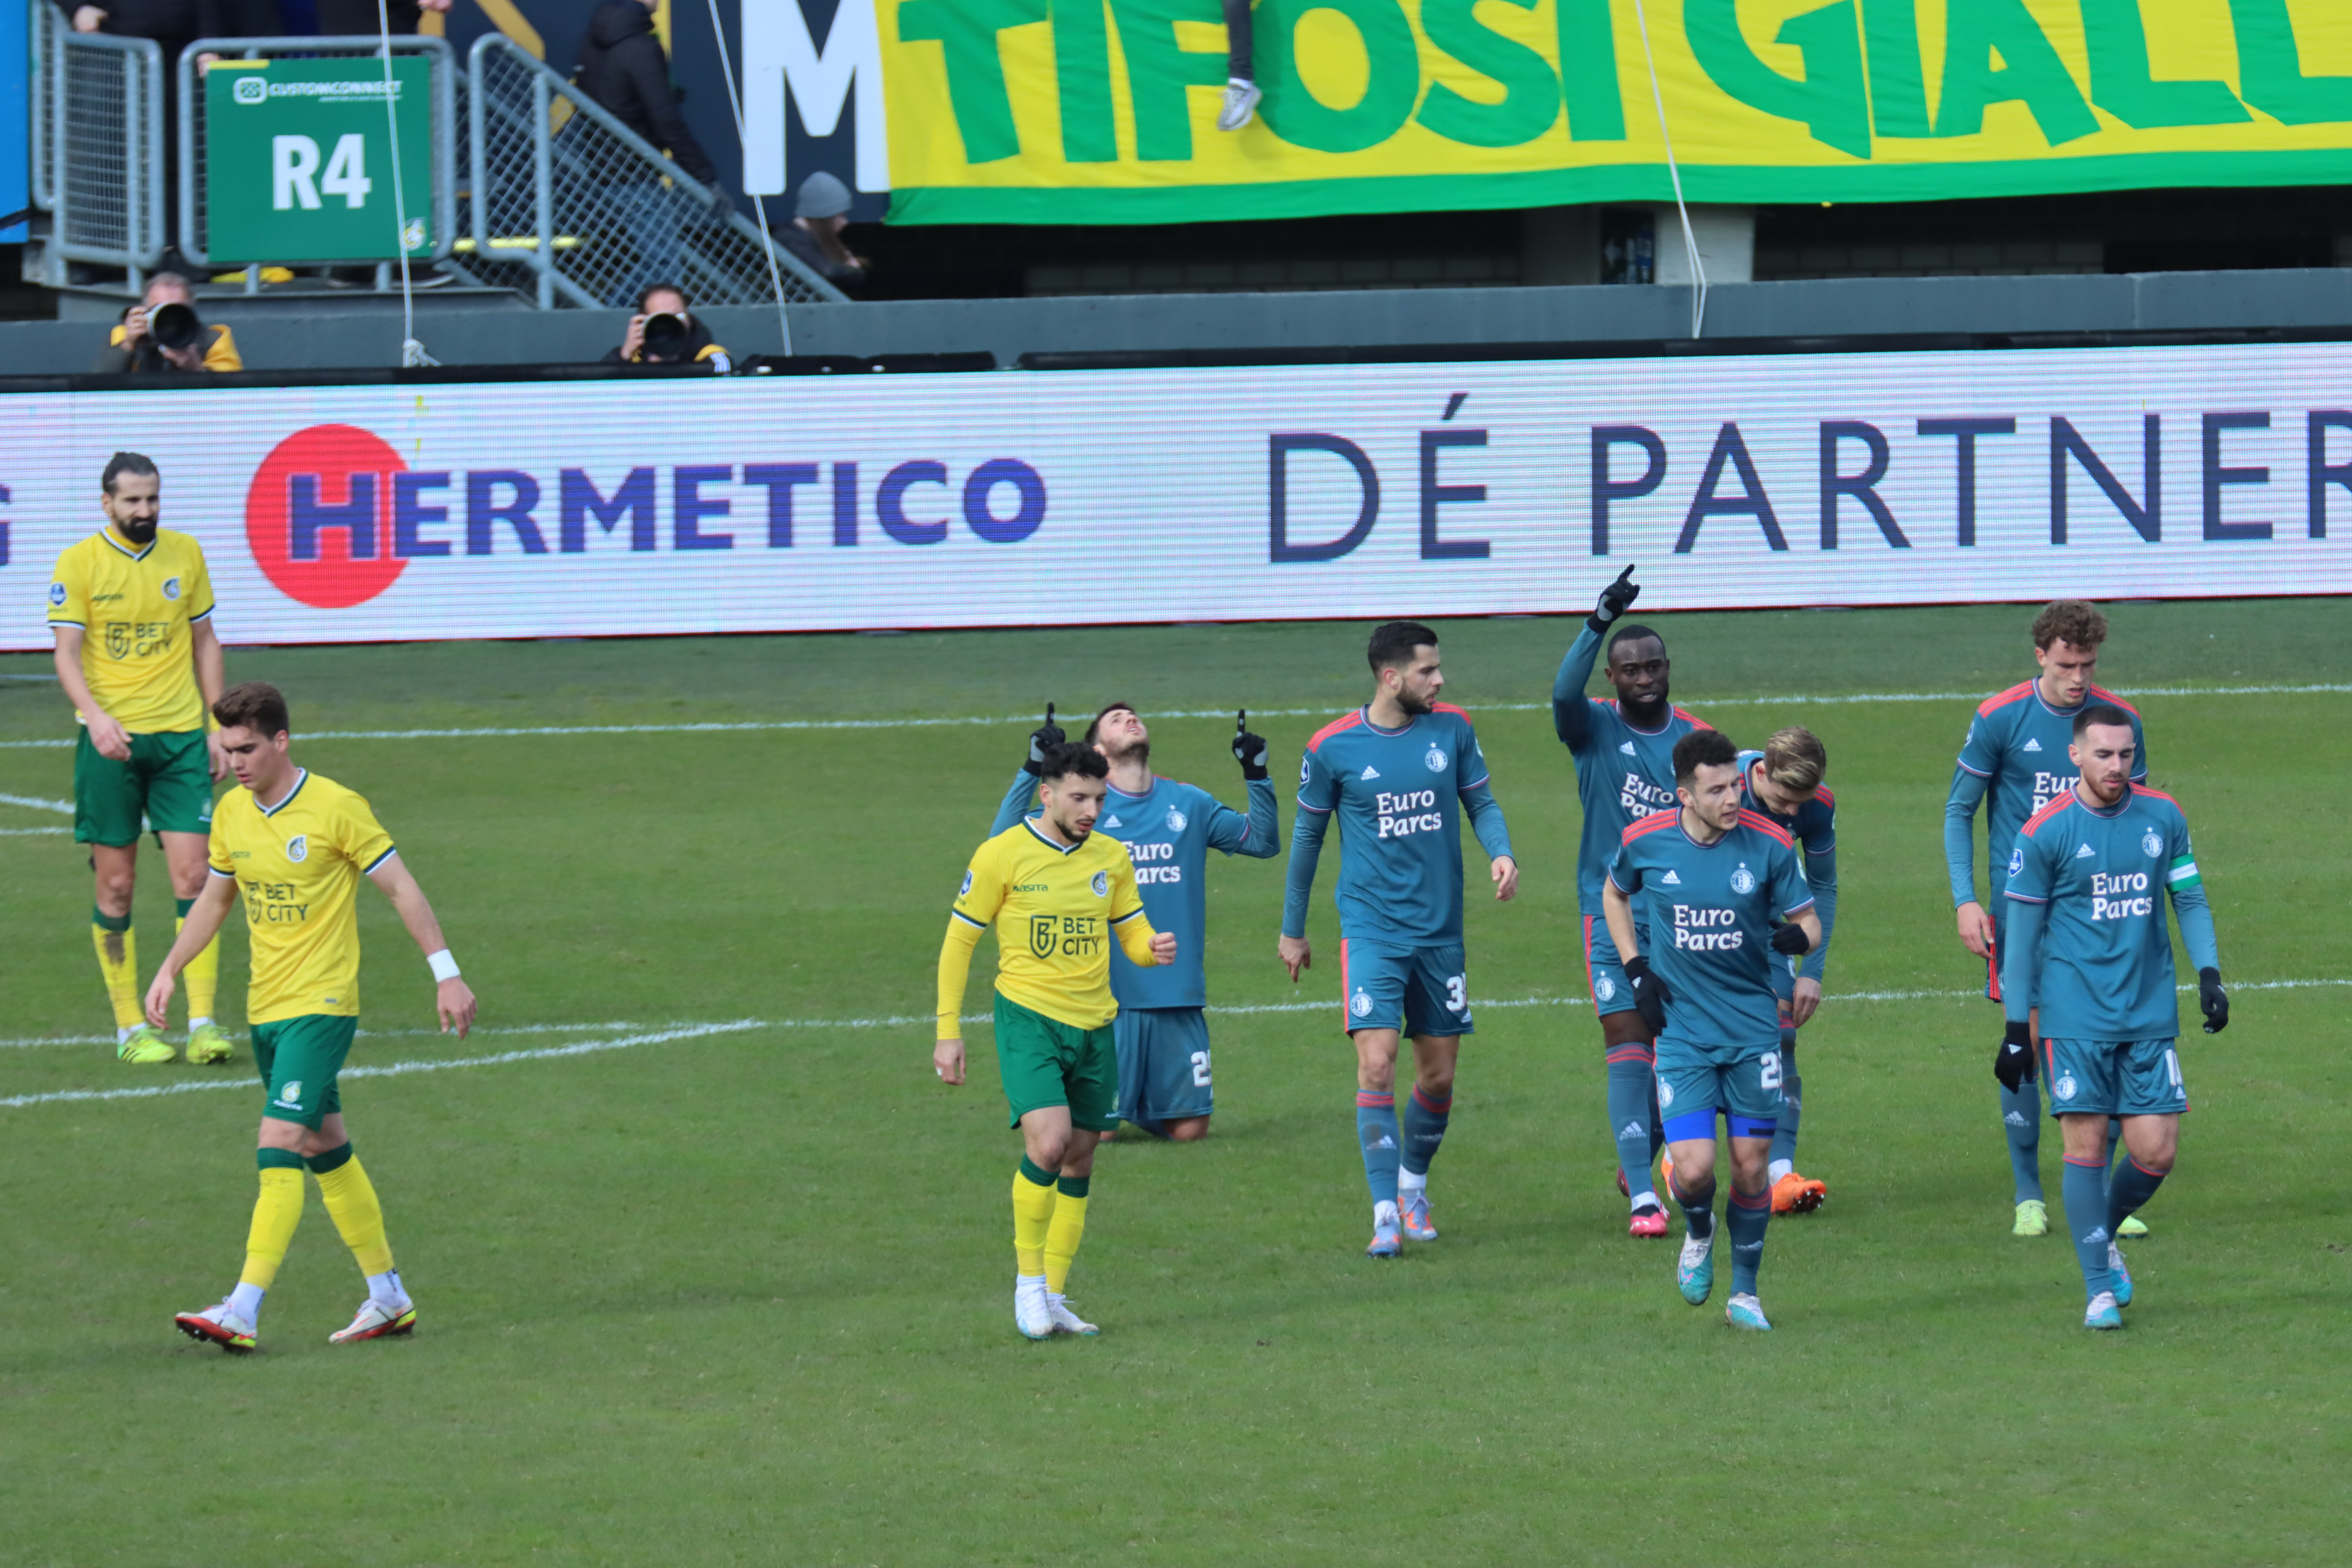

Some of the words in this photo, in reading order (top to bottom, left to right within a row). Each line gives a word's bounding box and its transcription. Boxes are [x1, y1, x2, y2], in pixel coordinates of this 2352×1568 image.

[898, 0, 1627, 165] TIFOSI
[272, 133, 372, 211] R4
[287, 458, 1047, 560] HERMETICO
[1270, 392, 1491, 564] DÉ
[135, 622, 170, 638] BET
[136, 638, 174, 657] CITY
[1623, 772, 1674, 804] Euro
[2034, 772, 2080, 794] Eur
[1376, 790, 1435, 815] Euro
[1621, 792, 1665, 819] Par
[1378, 812, 1442, 838] Parcs
[1134, 865, 1181, 884] arcs
[2090, 872, 2148, 895] Euro
[265, 883, 295, 900] BET
[267, 904, 309, 921] CITY
[1673, 904, 1735, 927] Euro
[2092, 896, 2153, 921] Parcs
[1063, 917, 1096, 935] BET
[1062, 938, 1099, 956] CITY
[1675, 927, 1743, 951] Parcs
[1191, 1049, 1213, 1087] 2
[1760, 1050, 1783, 1090] 2
